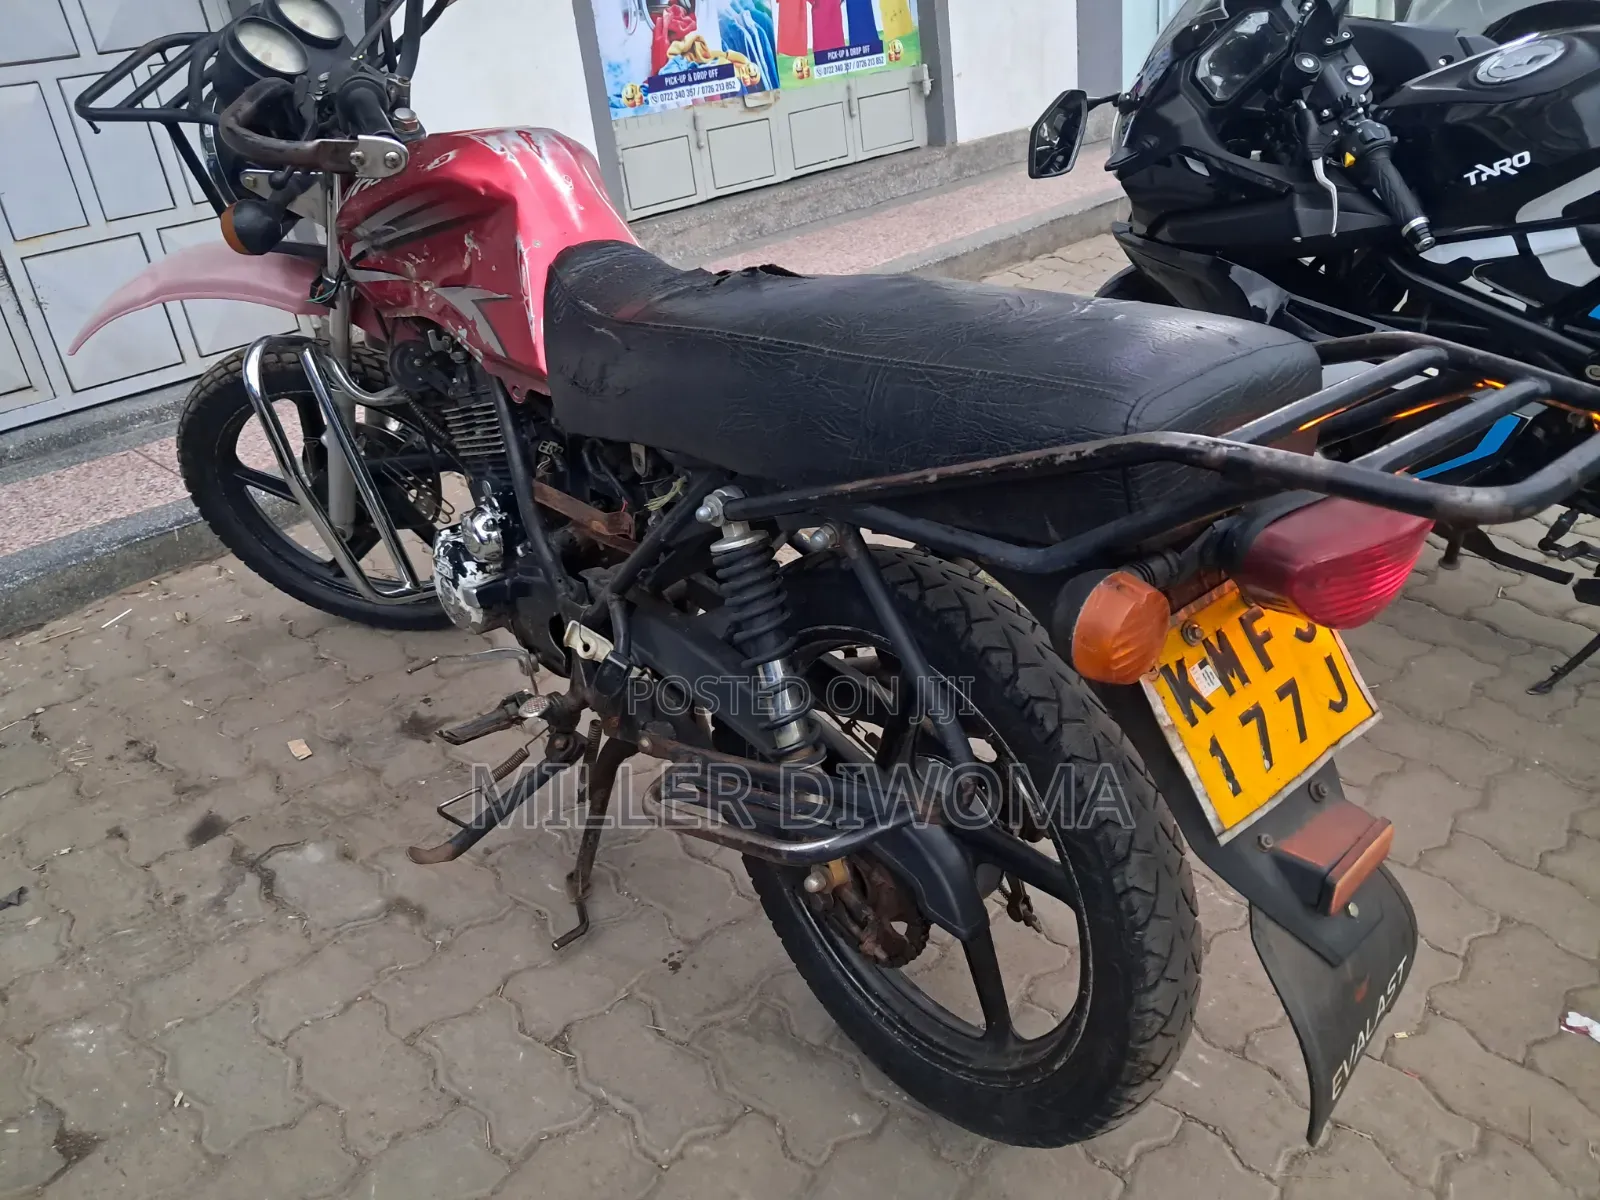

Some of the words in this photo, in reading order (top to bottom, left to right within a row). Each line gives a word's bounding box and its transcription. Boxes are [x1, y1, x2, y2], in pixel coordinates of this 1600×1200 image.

[827, 50, 845, 60] PICK-UP
[850, 47, 861, 56] DROP
[862, 45, 870, 54] OFF
[664, 75, 686, 86] PICK-UP
[687, 74, 693, 82] &
[693, 71, 707, 81] DROP
[708, 68, 718, 78] OFF
[660, 91, 673, 102] 0722
[675, 89, 685, 100] 340
[701, 84, 714, 95] 0726
[716, 82, 725, 92] 213
[1463, 150, 1531, 186] TARO
[1208, 653, 1349, 797] 177J
[1332, 955, 1407, 1100] EVALAST
